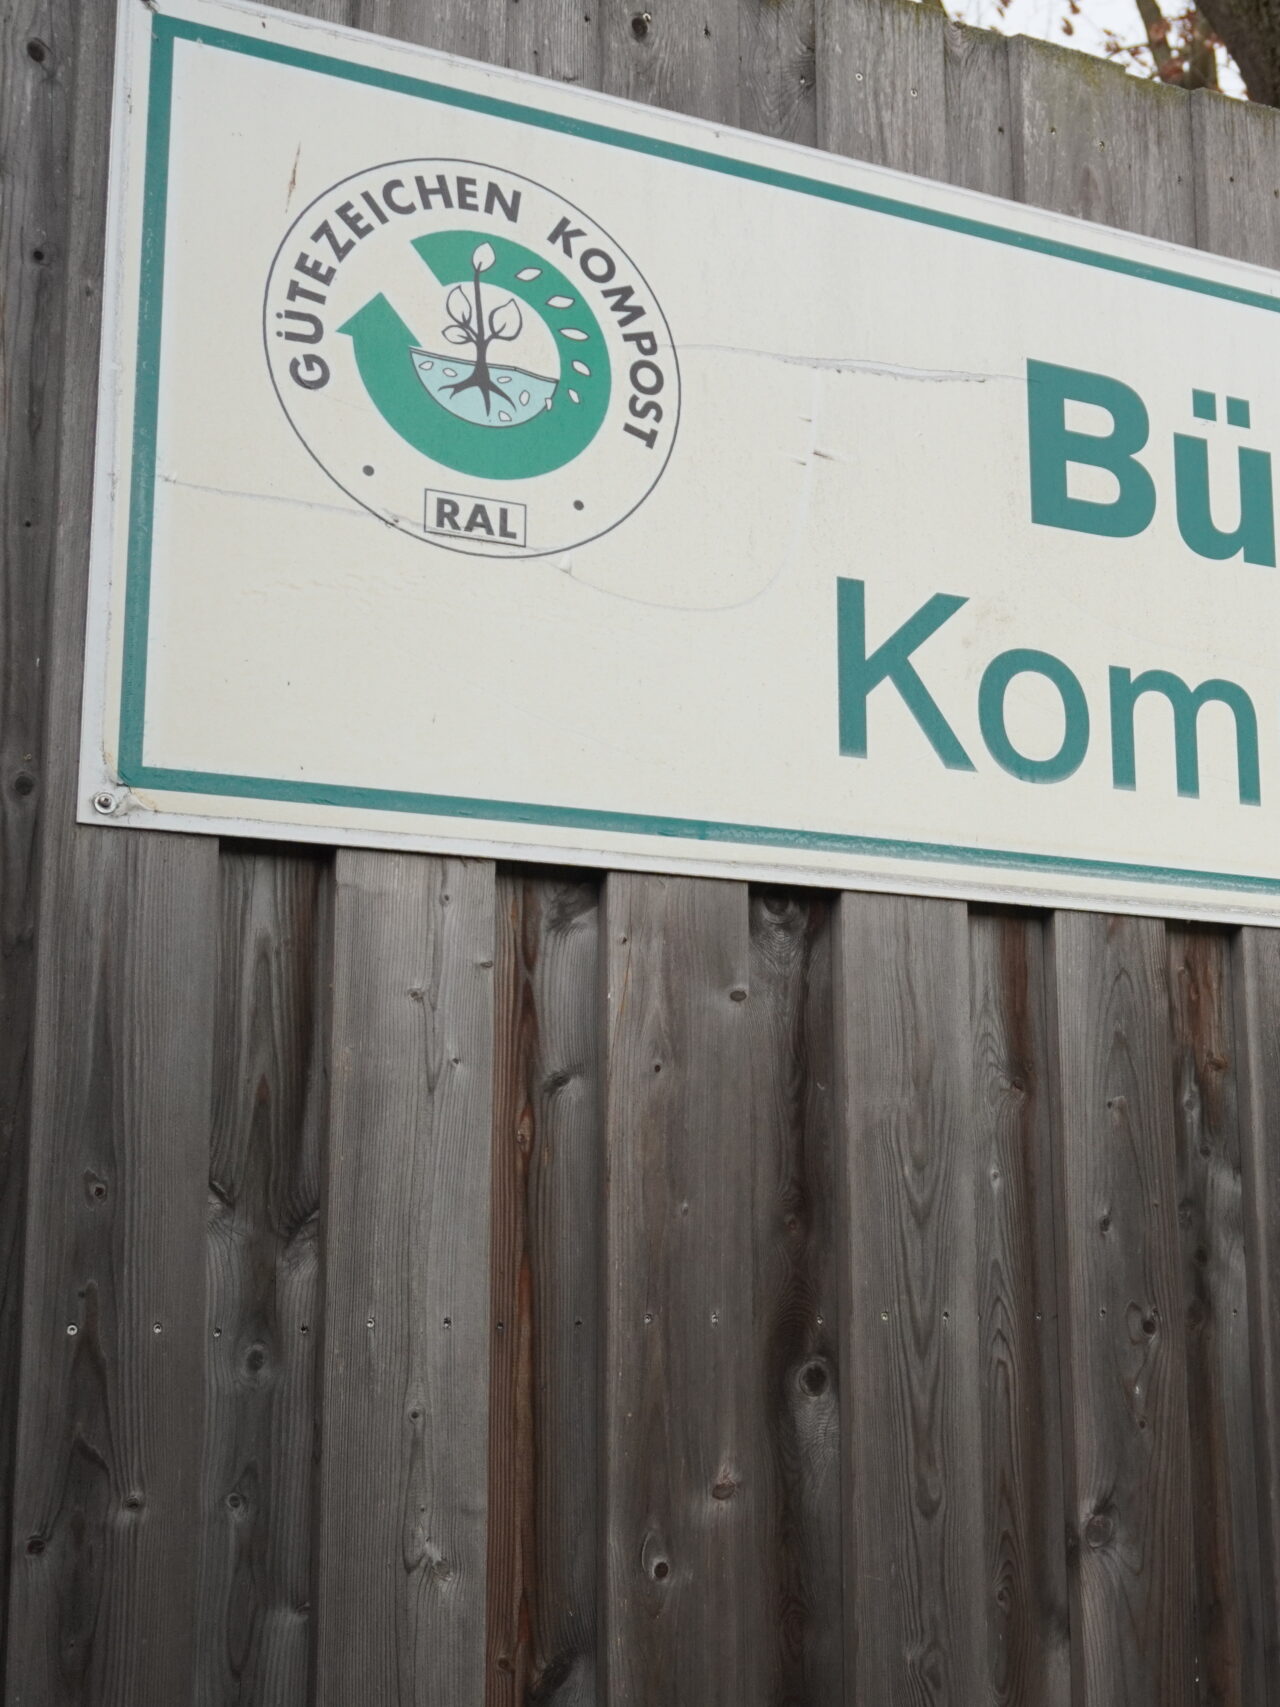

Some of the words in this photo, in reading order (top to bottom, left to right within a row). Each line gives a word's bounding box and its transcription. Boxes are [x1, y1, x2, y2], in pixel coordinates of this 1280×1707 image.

[276, 174, 522, 390] GÜTEZEICHEN
[546, 216, 665, 449] KOMPOST
[435, 497, 518, 539] RAL
